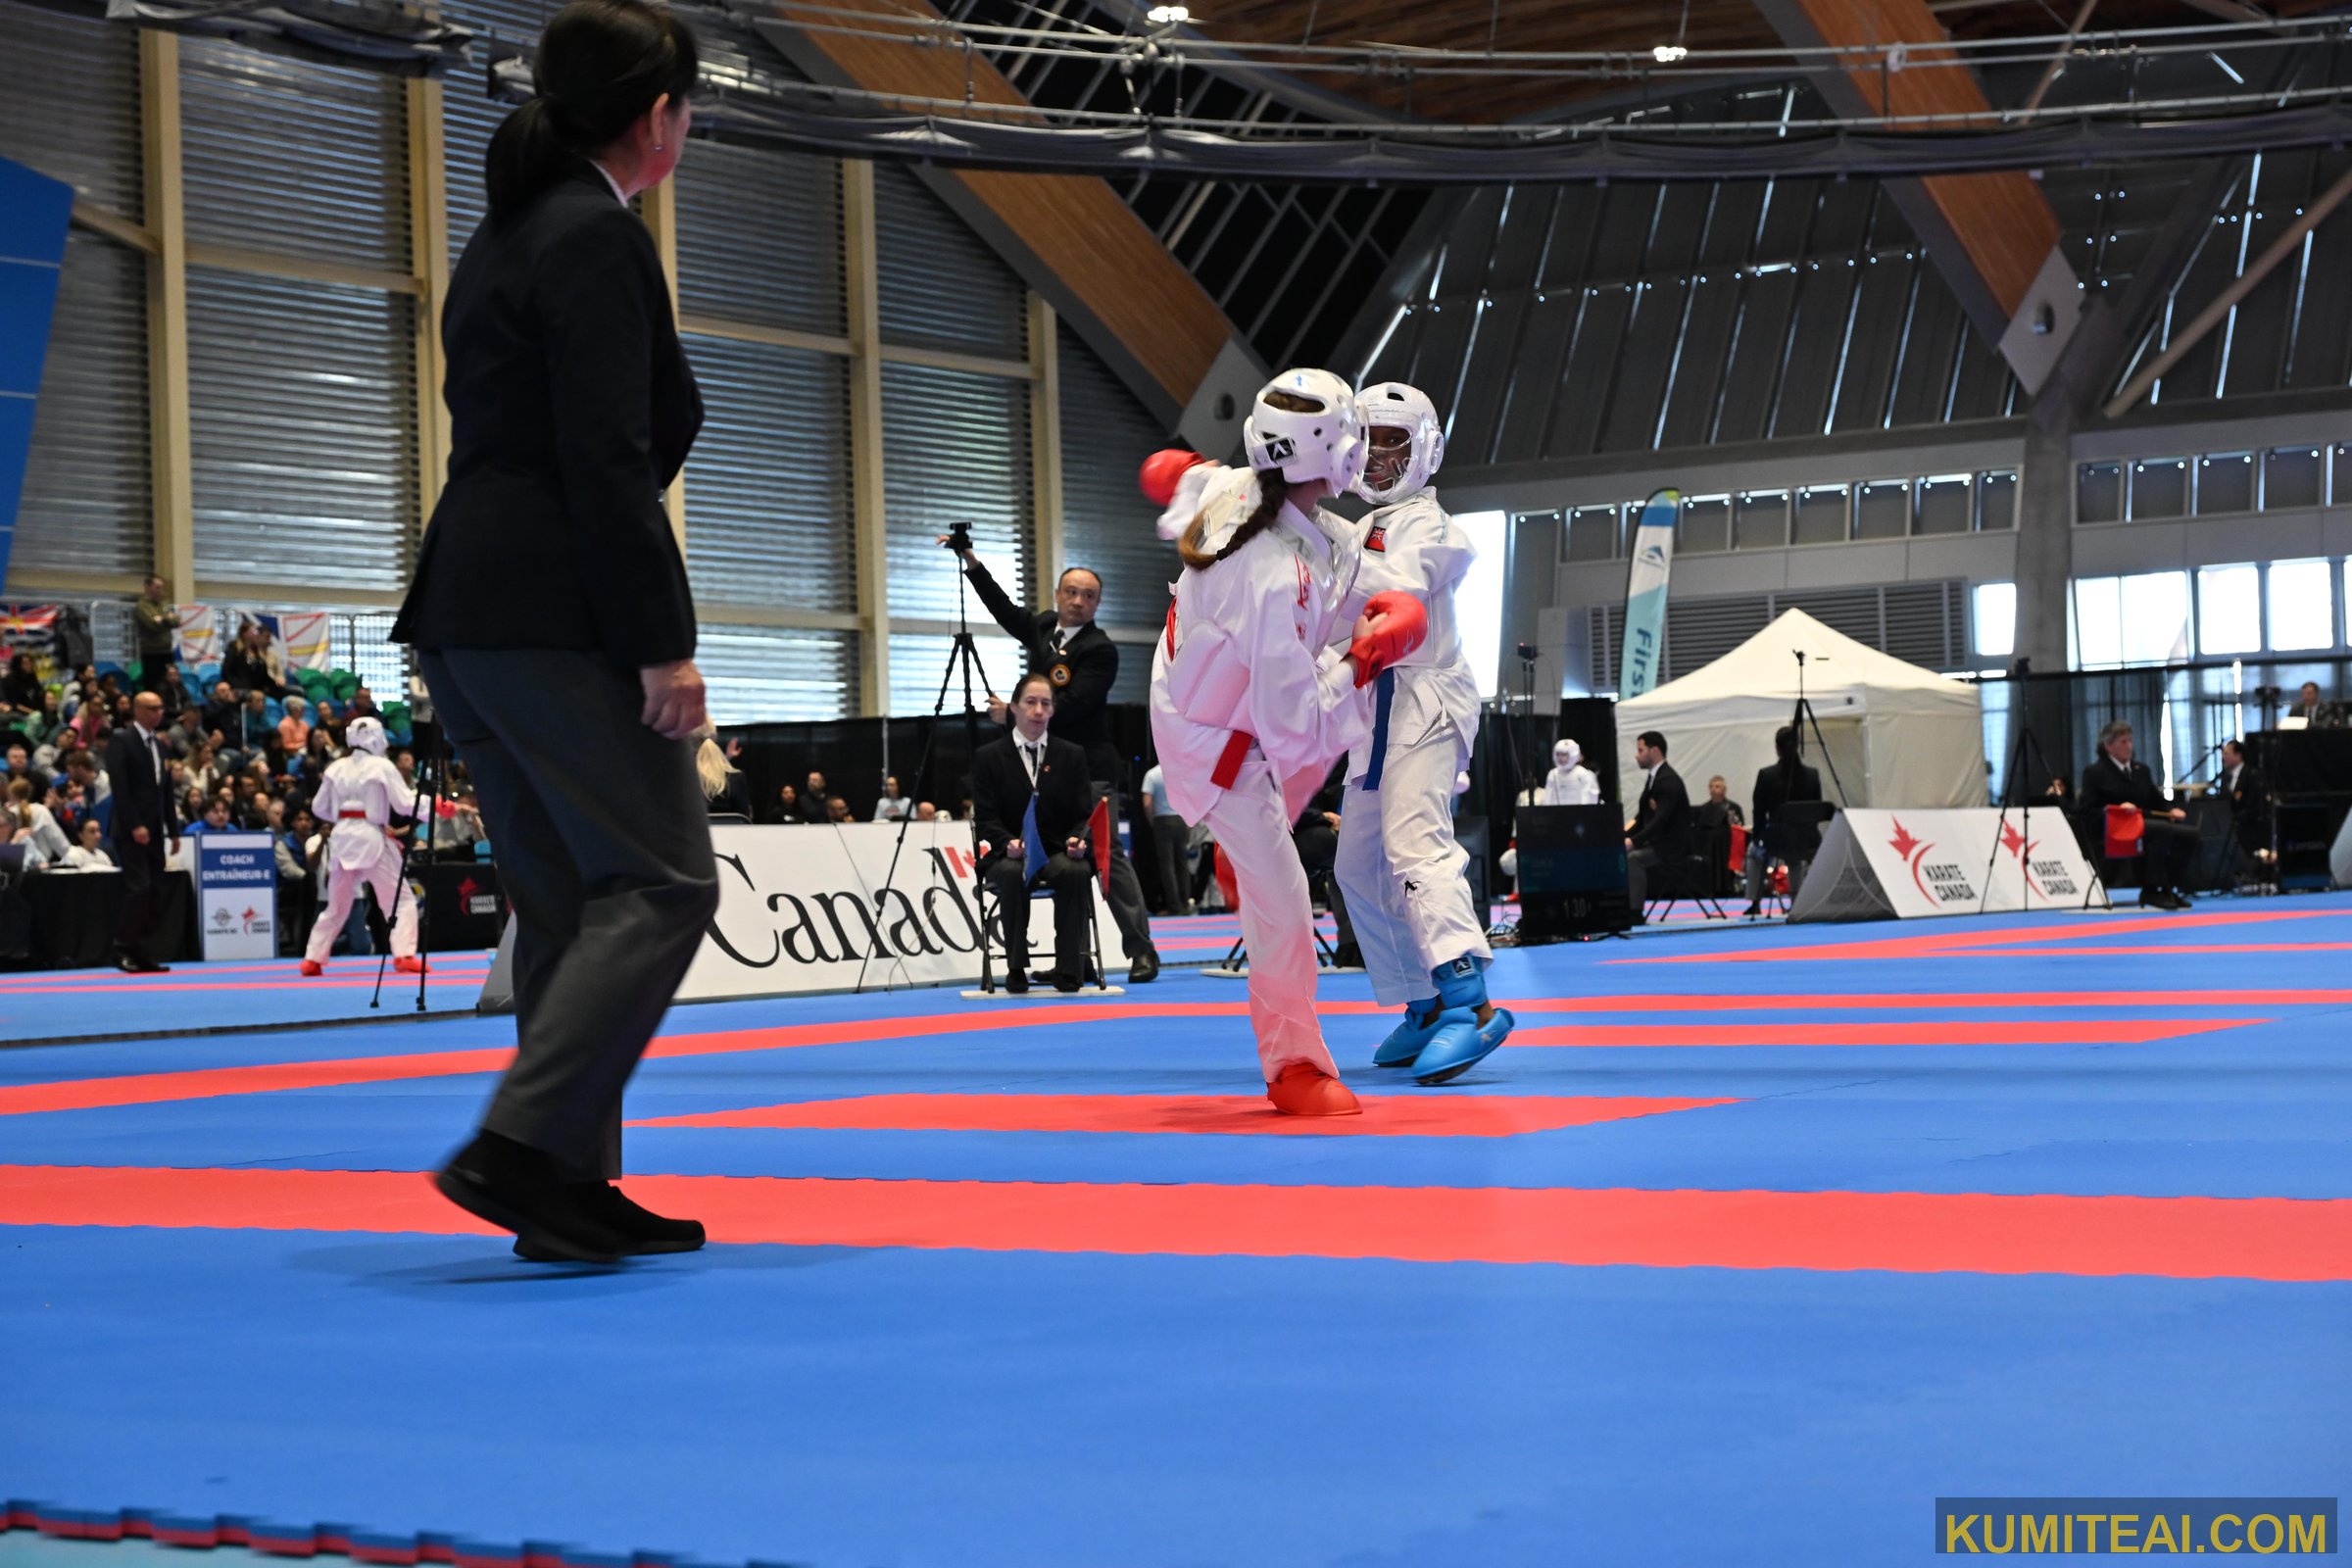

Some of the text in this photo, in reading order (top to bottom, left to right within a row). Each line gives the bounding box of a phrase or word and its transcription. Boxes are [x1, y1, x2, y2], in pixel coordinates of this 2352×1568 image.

[220, 854, 255, 865] COACH
[1923, 864, 1966, 882] KARATE
[2032, 860, 2069, 878] KARATE
[1935, 883, 1979, 902] CANADA
[2041, 878, 2080, 896] CANADA
